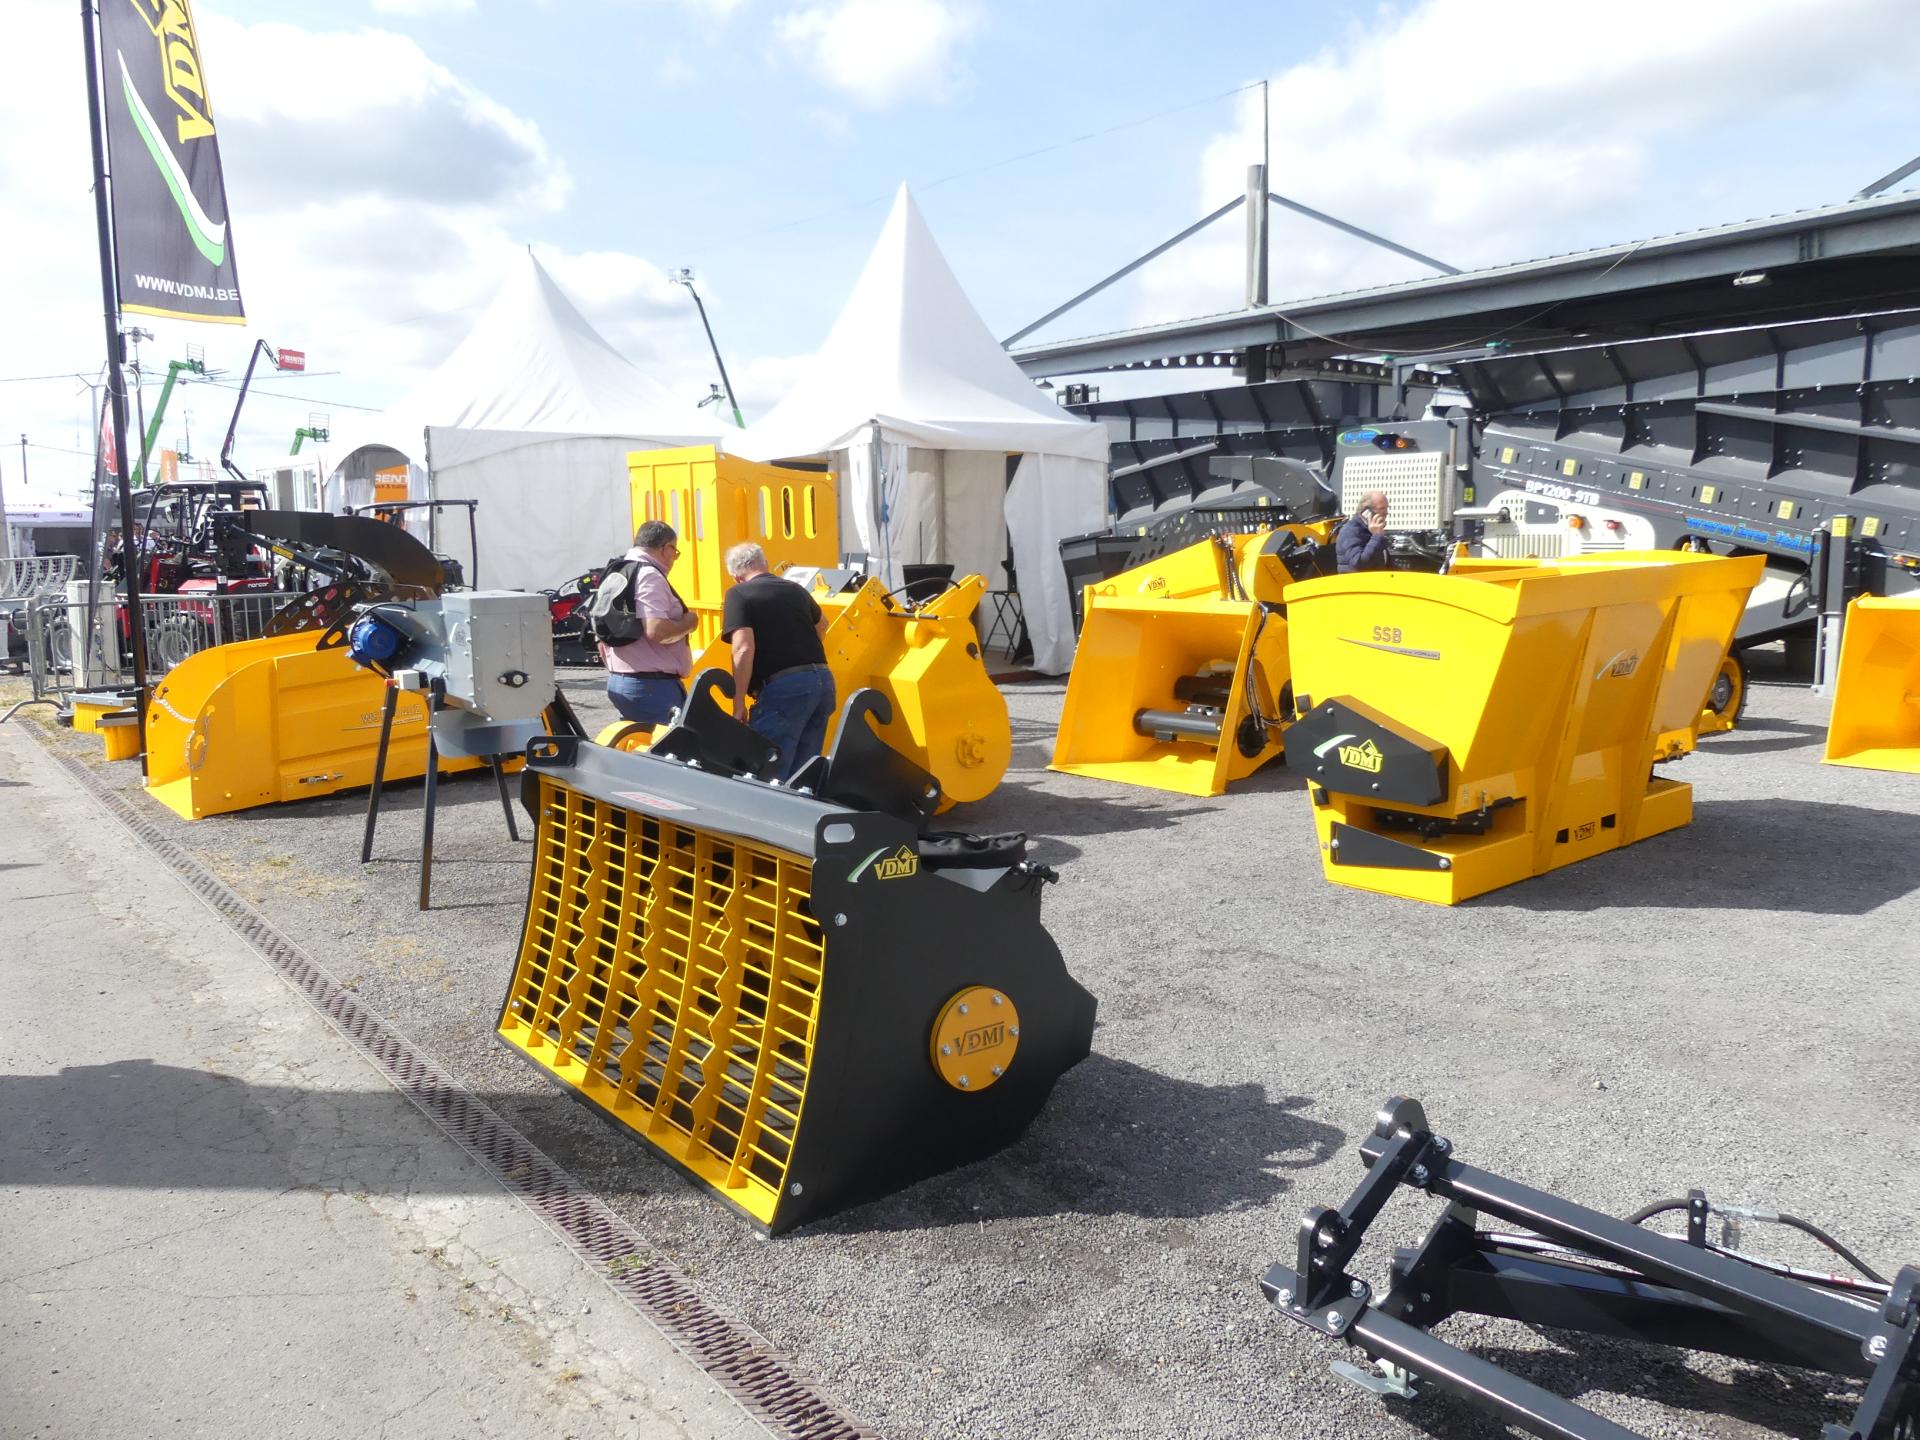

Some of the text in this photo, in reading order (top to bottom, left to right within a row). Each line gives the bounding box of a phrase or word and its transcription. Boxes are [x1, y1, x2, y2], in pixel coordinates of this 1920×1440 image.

[135, 274, 240, 301] WWW.VDMJ.BE
[1525, 480, 1600, 505] BP1200-9TB
[1372, 625, 1402, 644] SSB
[1338, 746, 1384, 773] VDMJ
[874, 855, 918, 881] VDMJ
[953, 1021, 1005, 1056] VDMJ
